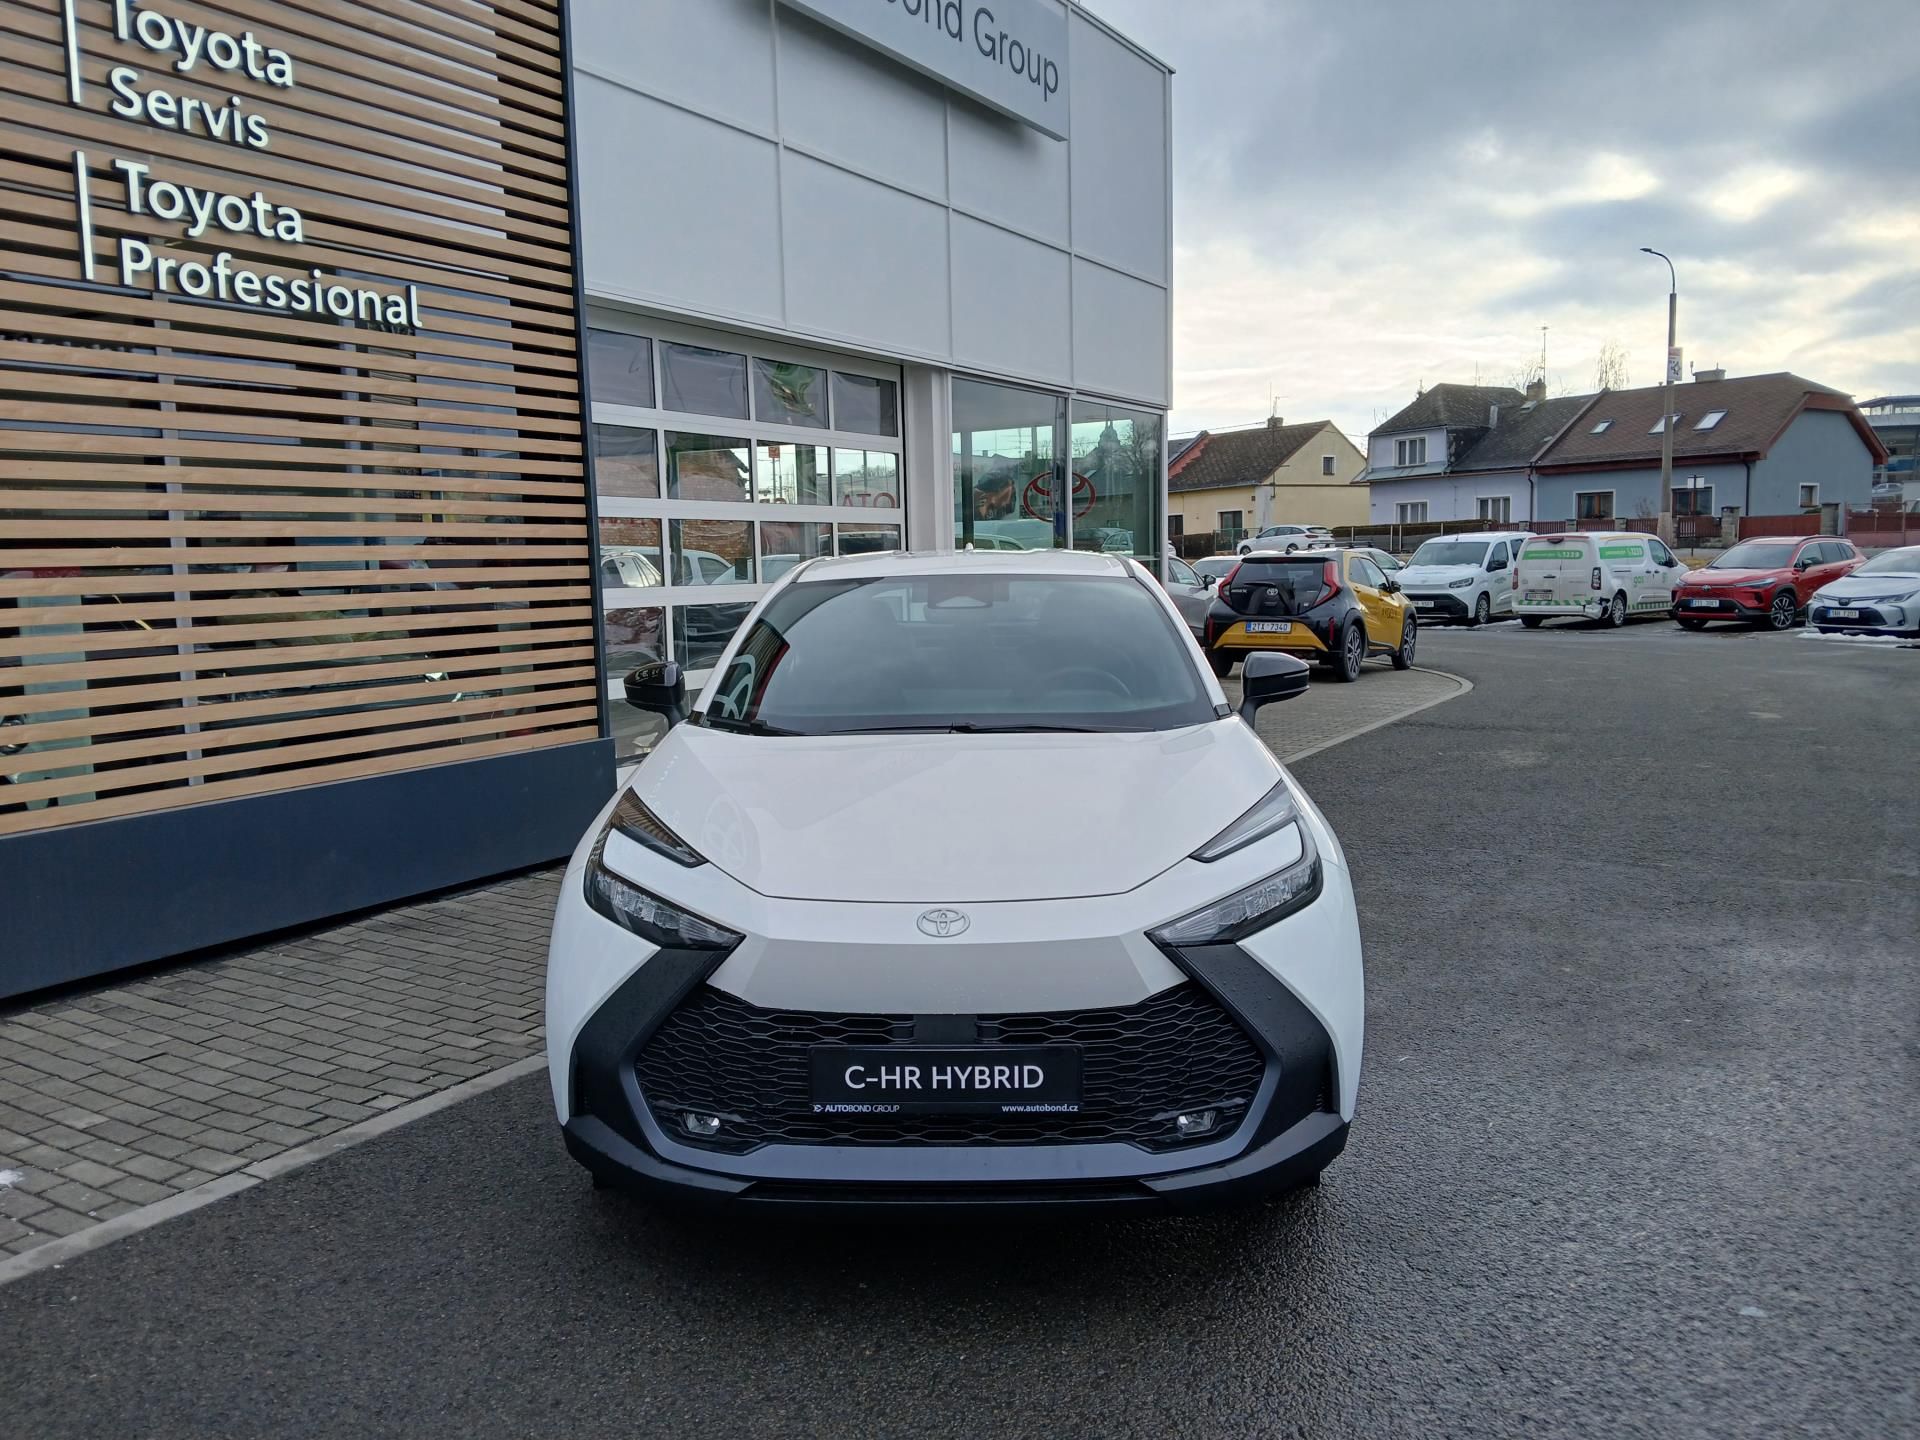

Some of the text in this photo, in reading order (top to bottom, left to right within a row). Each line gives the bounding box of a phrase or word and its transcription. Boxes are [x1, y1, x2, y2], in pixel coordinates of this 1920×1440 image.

[113, 0, 293, 87] Toyota
[974, 7, 1059, 102] Group
[110, 67, 269, 147] Servis
[115, 159, 303, 243] Toyota
[119, 238, 423, 328] Professional
[824, 1104, 900, 1113] AUTOBOND GROUP
[844, 1065, 1044, 1089] C-HR HYBRID
[1001, 1103, 1079, 1113] www.autobond.cz
